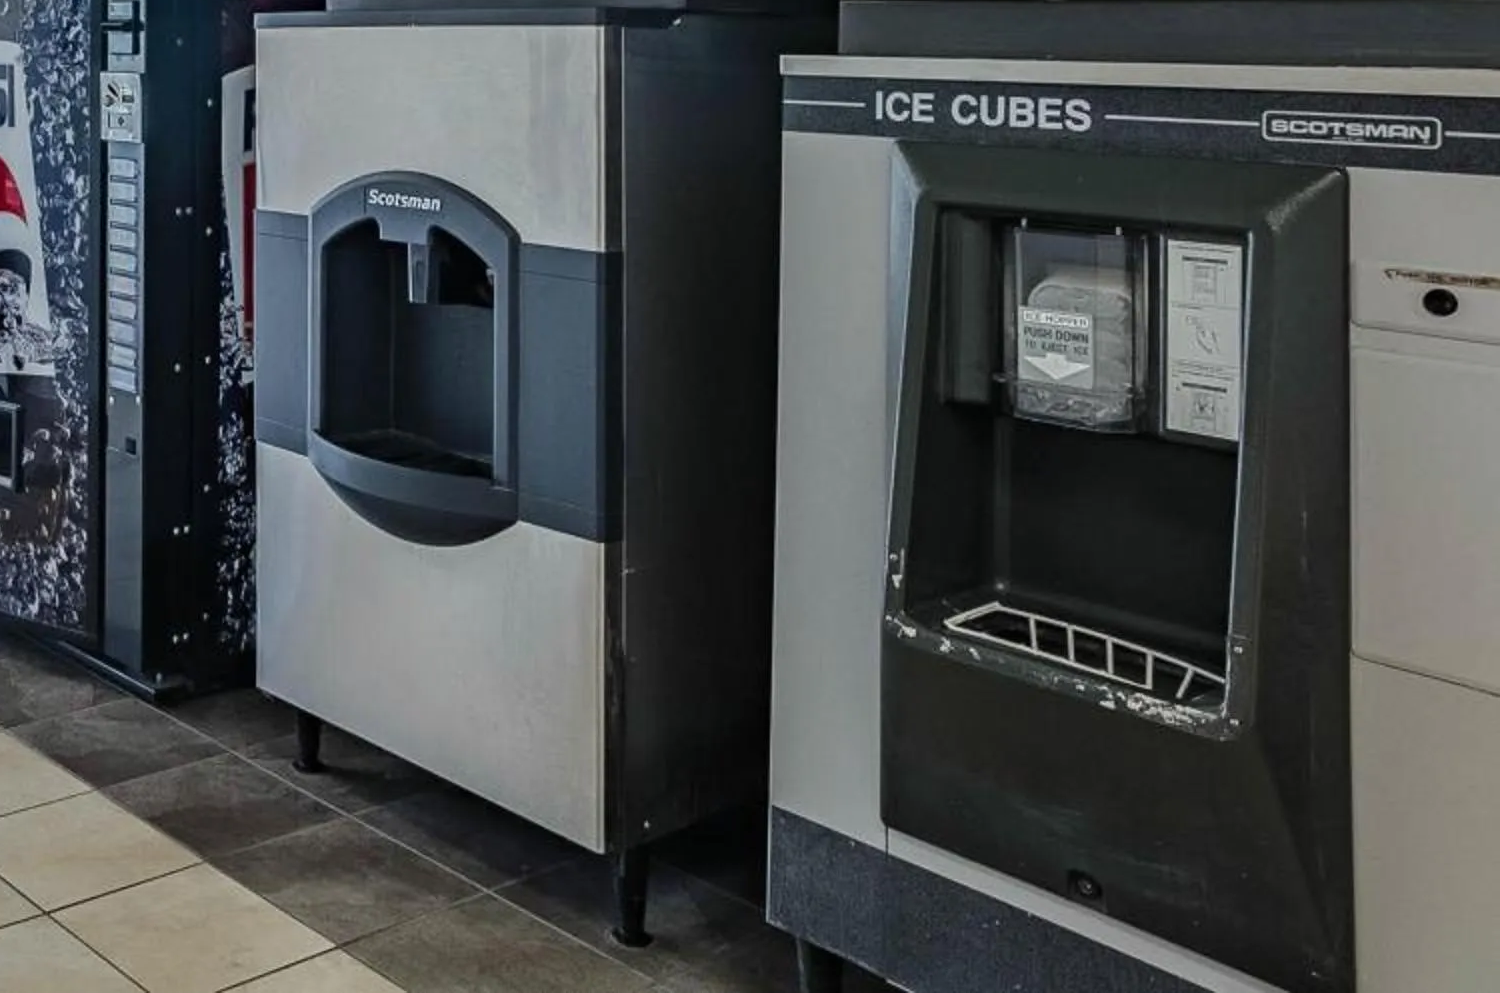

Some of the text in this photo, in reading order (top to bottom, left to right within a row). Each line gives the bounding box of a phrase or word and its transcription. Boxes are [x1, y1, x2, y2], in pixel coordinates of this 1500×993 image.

[875, 90, 1092, 132] ICE CUBES
[1270, 118, 1431, 141] SCOTSMAN
[367, 188, 441, 211] Scotsman
[1056, 329, 1089, 344] DOWN
